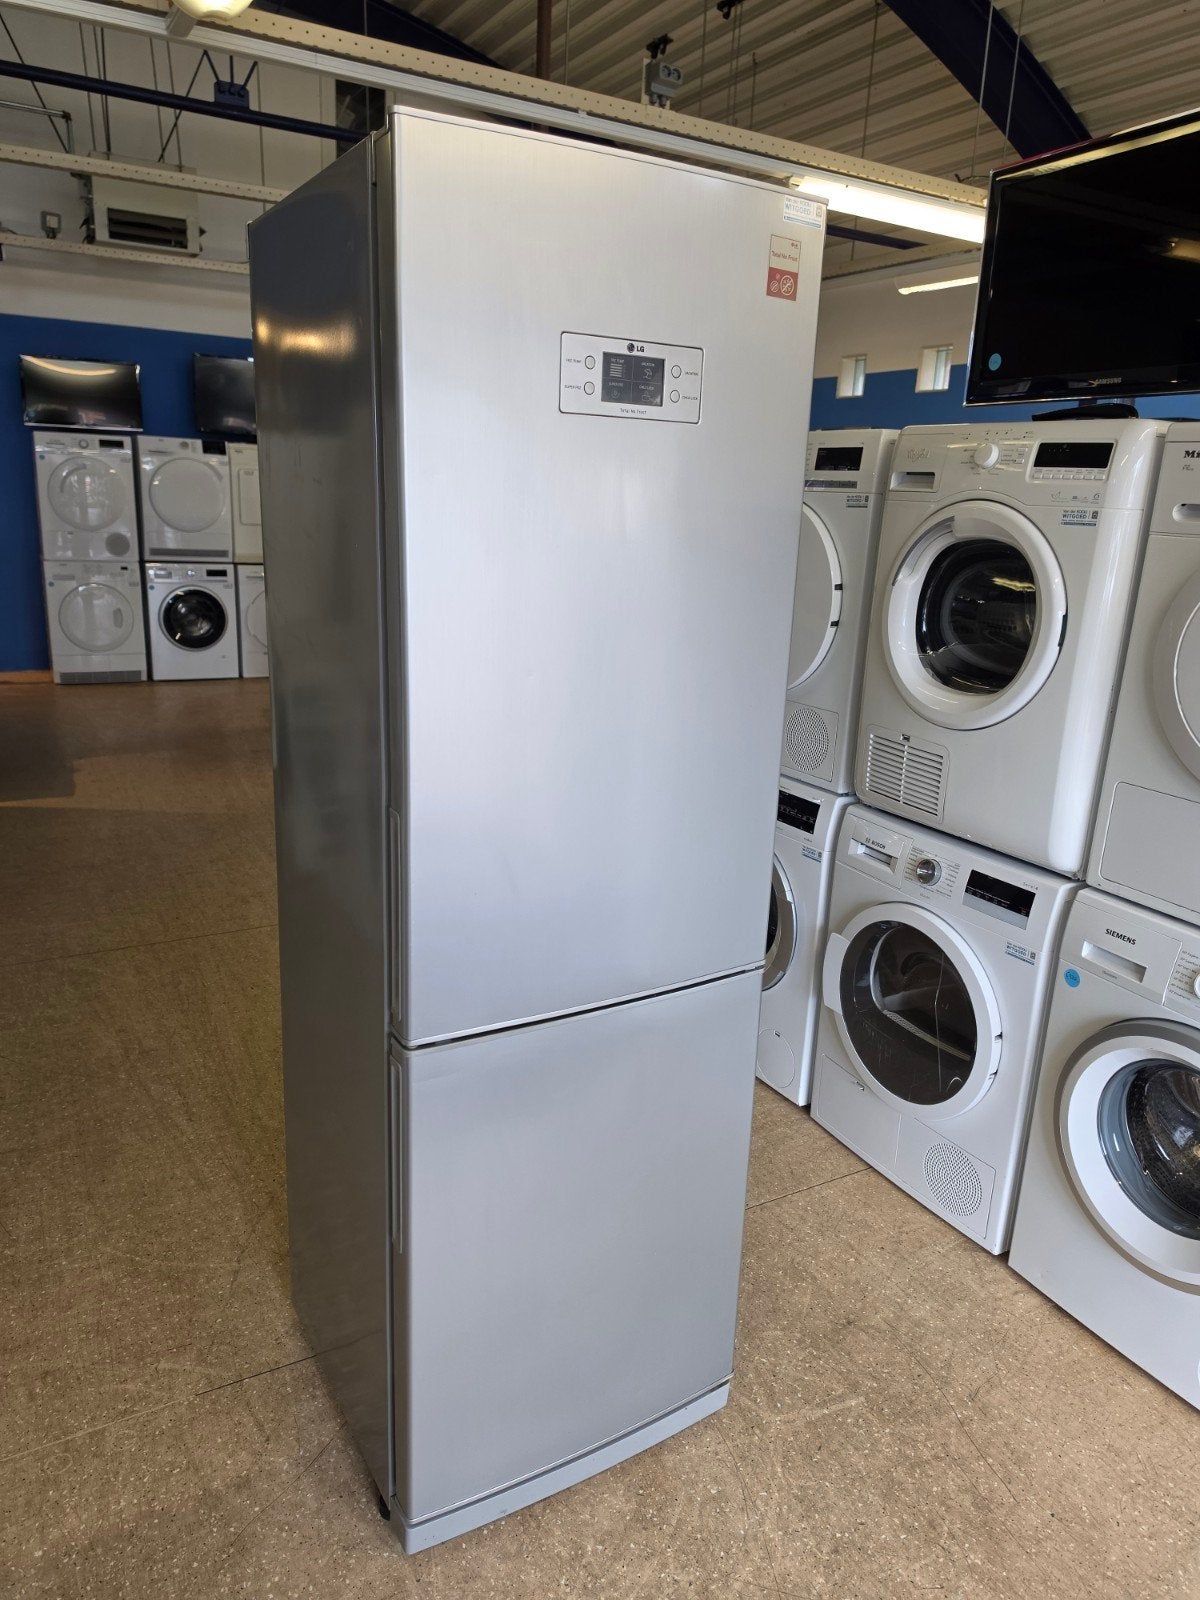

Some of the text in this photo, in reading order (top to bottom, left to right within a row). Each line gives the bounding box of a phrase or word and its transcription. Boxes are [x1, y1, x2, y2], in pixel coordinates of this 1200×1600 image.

[636, 345, 645, 353] LG
[871, 840, 886, 850] BOSCH
[1105, 928, 1137, 946] SIEMENS
